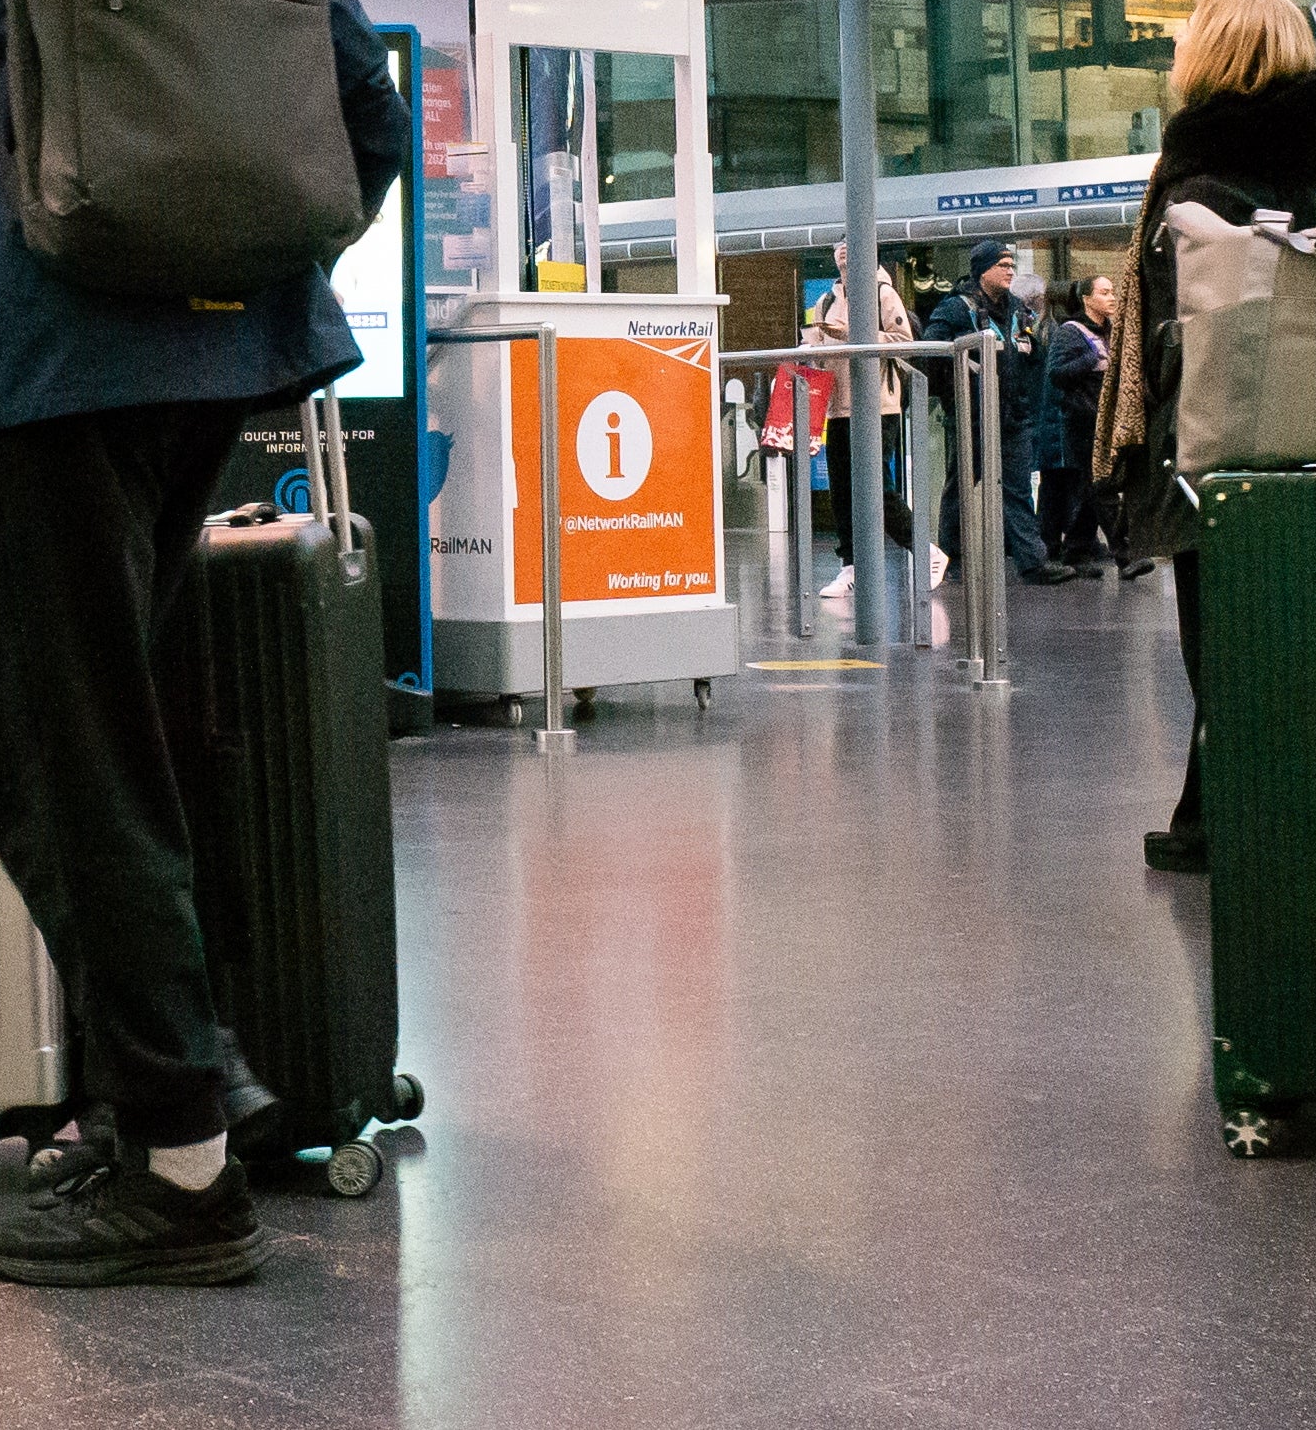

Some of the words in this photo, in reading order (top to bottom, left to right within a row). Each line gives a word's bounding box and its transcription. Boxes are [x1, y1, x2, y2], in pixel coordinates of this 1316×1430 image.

[627, 321, 713, 336] NetworkRail
[279, 431, 301, 441] THE
[352, 430, 375, 440] FOR
[565, 512, 683, 534] @NetworkRailMAN
[607, 572, 660, 590] Working
[664, 571, 682, 586] for
[685, 572, 711, 589] you.
